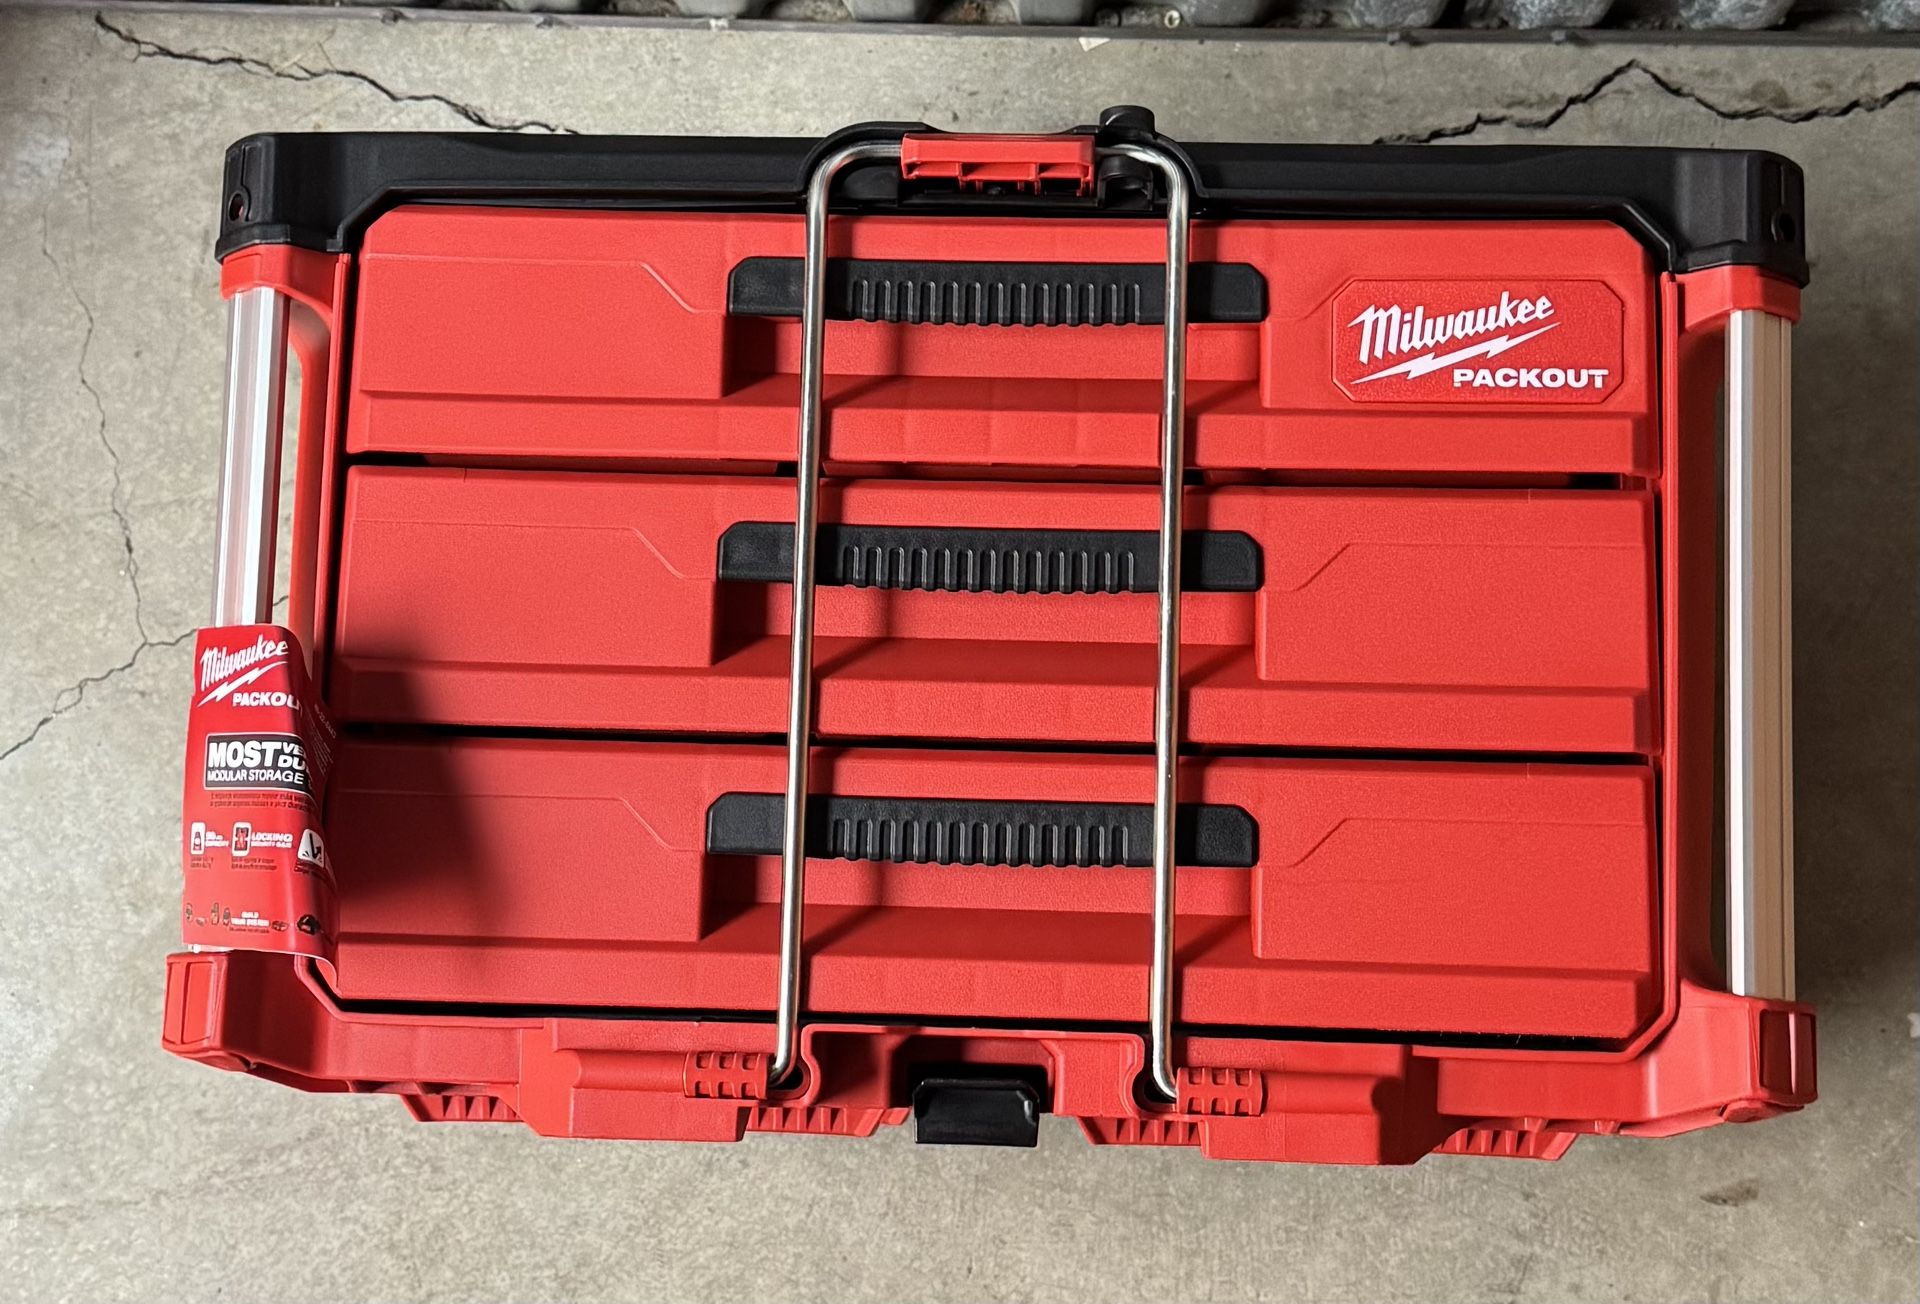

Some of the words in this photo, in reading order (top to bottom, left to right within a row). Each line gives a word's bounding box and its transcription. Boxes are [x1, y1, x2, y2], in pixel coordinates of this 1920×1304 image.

[1347, 290, 1555, 365] Milwaukee
[1453, 368, 1609, 388] PACKOUT
[200, 634, 289, 692] Milwaukee
[208, 740, 282, 768] MOST
[207, 769, 246, 782] MODULAR
[248, 769, 305, 784] STORAGE
